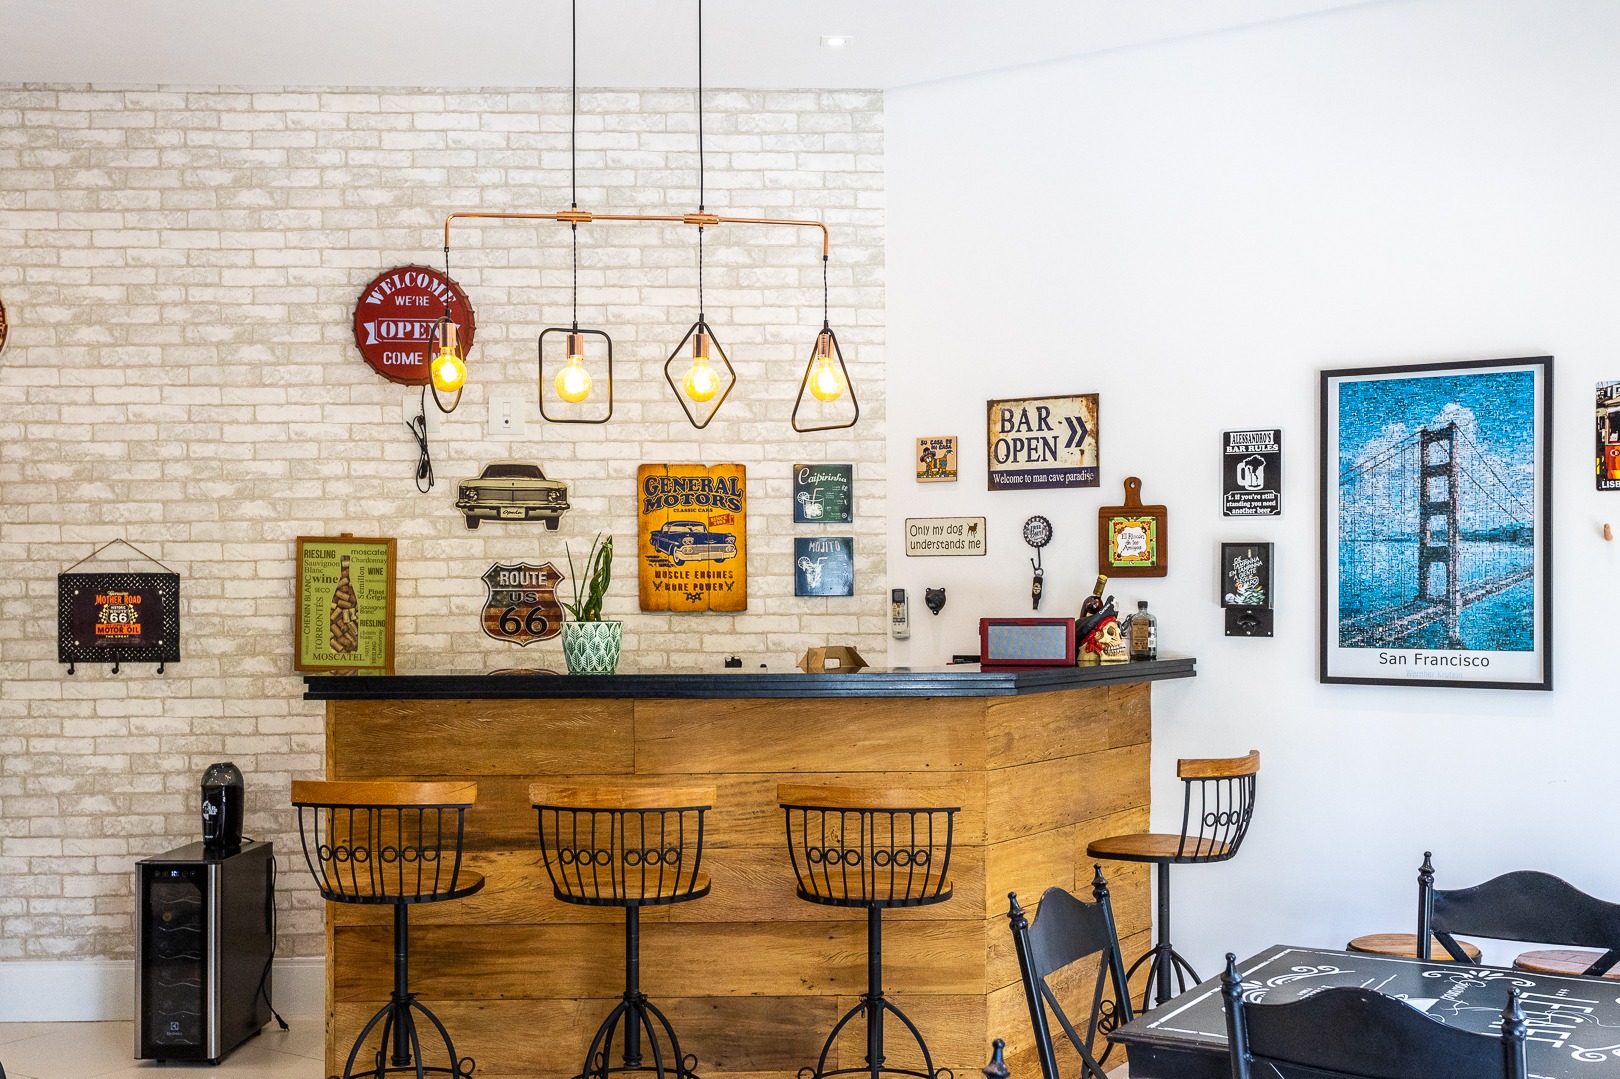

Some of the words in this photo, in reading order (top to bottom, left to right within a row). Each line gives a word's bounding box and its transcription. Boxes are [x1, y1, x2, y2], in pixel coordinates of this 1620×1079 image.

[365, 271, 457, 306] WELCOME
[394, 295, 430, 306] WE'RE
[383, 351, 423, 365] COME
[999, 405, 1054, 434] BAR
[1231, 432, 1272, 445] ALESSANDRO'S
[993, 435, 1060, 465] OPEN
[1226, 445, 1247, 453] BAR
[1247, 444, 1279, 452] RULES
[798, 467, 847, 485] Caipirinha
[993, 473, 1024, 484] Welcome
[1024, 474, 1032, 483] to
[1032, 474, 1048, 482] man
[1048, 473, 1065, 482] cave
[1065, 470, 1095, 484] paradise
[643, 475, 744, 499] GENERAL
[643, 493, 742, 515] MOTORS
[910, 524, 929, 537] Only
[932, 525, 944, 536] my
[946, 523, 964, 536] dog
[808, 541, 841, 553] MOJITO
[910, 537, 966, 550] understands
[968, 538, 981, 549] me
[303, 549, 336, 559] RIESLING
[304, 559, 340, 568] Sauvignon
[350, 557, 387, 565] Chardonnay
[367, 567, 384, 576] WINE
[654, 570, 690, 580] MUSCLE
[694, 570, 734, 580] ENGINES
[312, 573, 339, 584] wine
[499, 570, 548, 587] ROUTE
[304, 574, 312, 602] BLANC
[664, 582, 689, 592] MORE
[693, 582, 724, 592] POWER
[95, 594, 122, 605] MOTHER
[124, 595, 142, 604] ROAD
[508, 591, 539, 604] US
[110, 613, 127, 623] 66
[303, 603, 311, 635] CHENIN
[314, 596, 324, 652] TORRONTÉS
[359, 619, 386, 628] RIESLING
[499, 605, 549, 636] 66
[312, 652, 365, 662] MOSCATEL
[1378, 651, 1407, 665] San
[1414, 653, 1490, 667] Francisco
